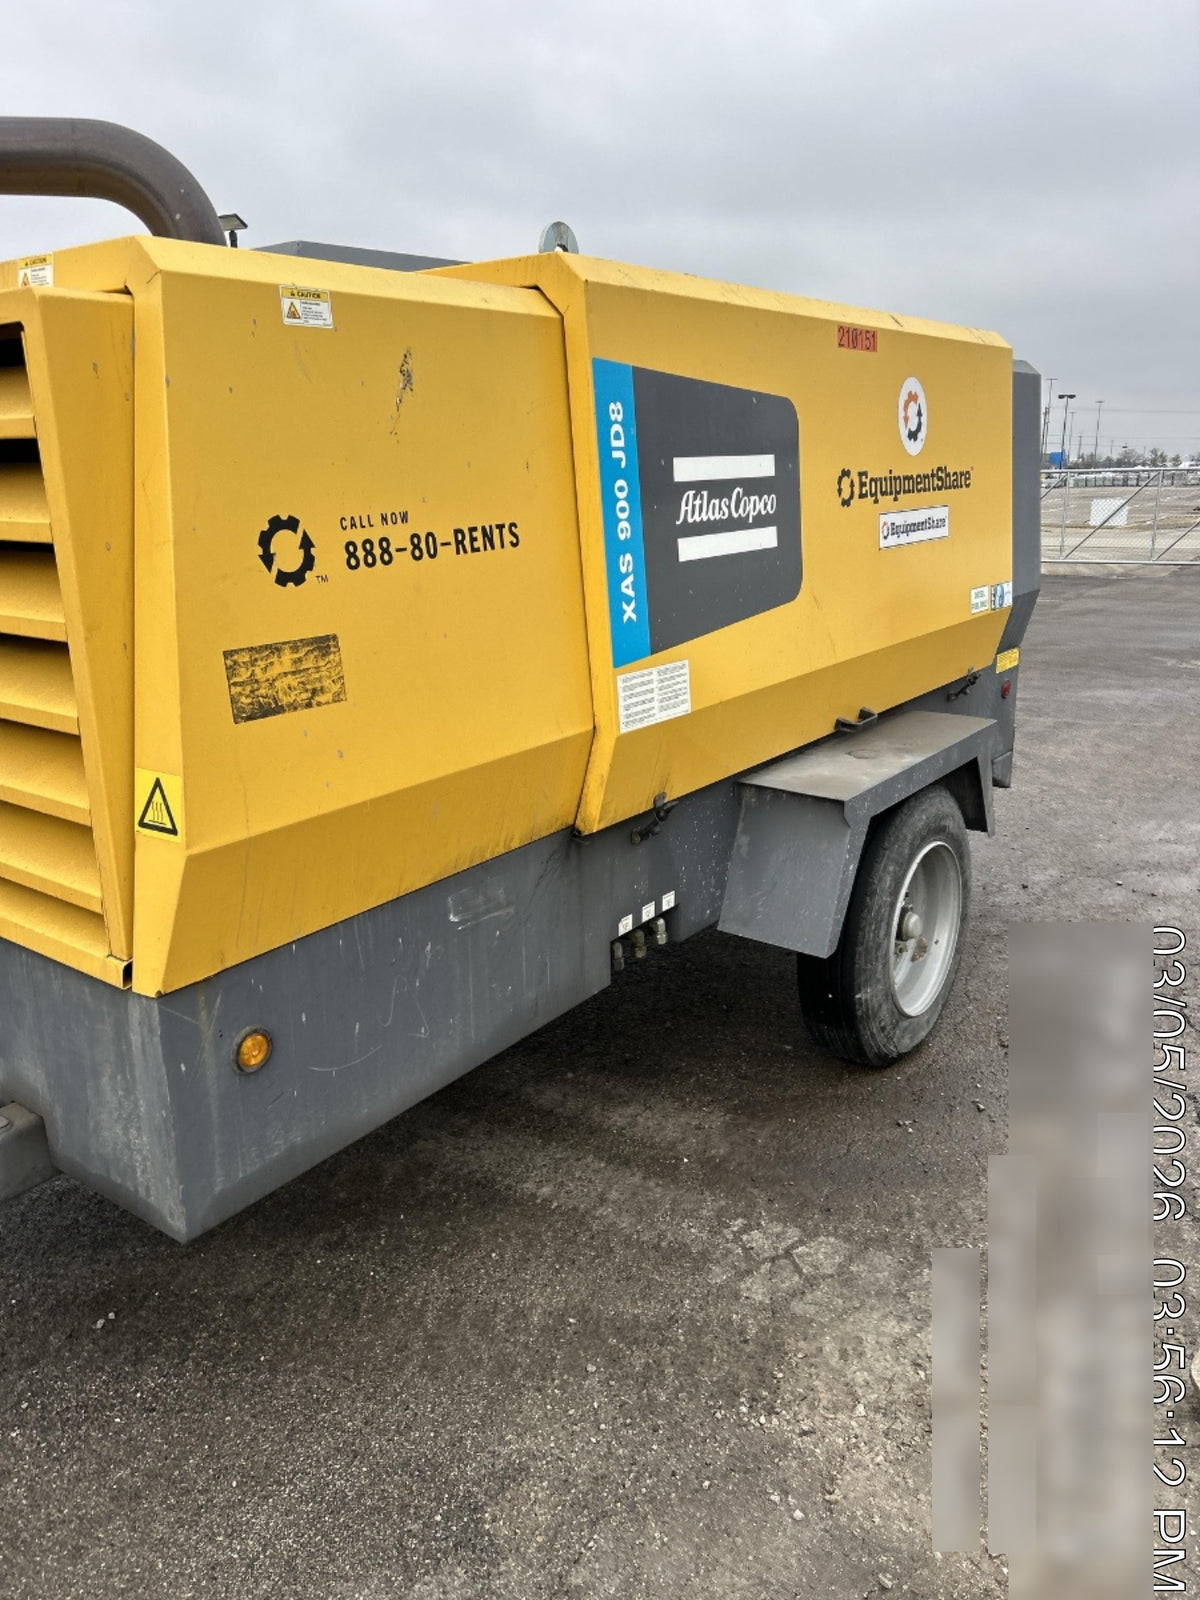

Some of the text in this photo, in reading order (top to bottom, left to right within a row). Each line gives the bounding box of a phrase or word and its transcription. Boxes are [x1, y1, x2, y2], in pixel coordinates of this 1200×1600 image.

[838, 326, 876, 351] 210151
[858, 466, 971, 504] EquipmentShare
[340, 510, 409, 530] CALL NOW
[609, 401, 637, 624] XAS 900 JD8
[890, 516, 947, 538] EquipmentShare
[344, 522, 520, 570] 888-80-RENTS
